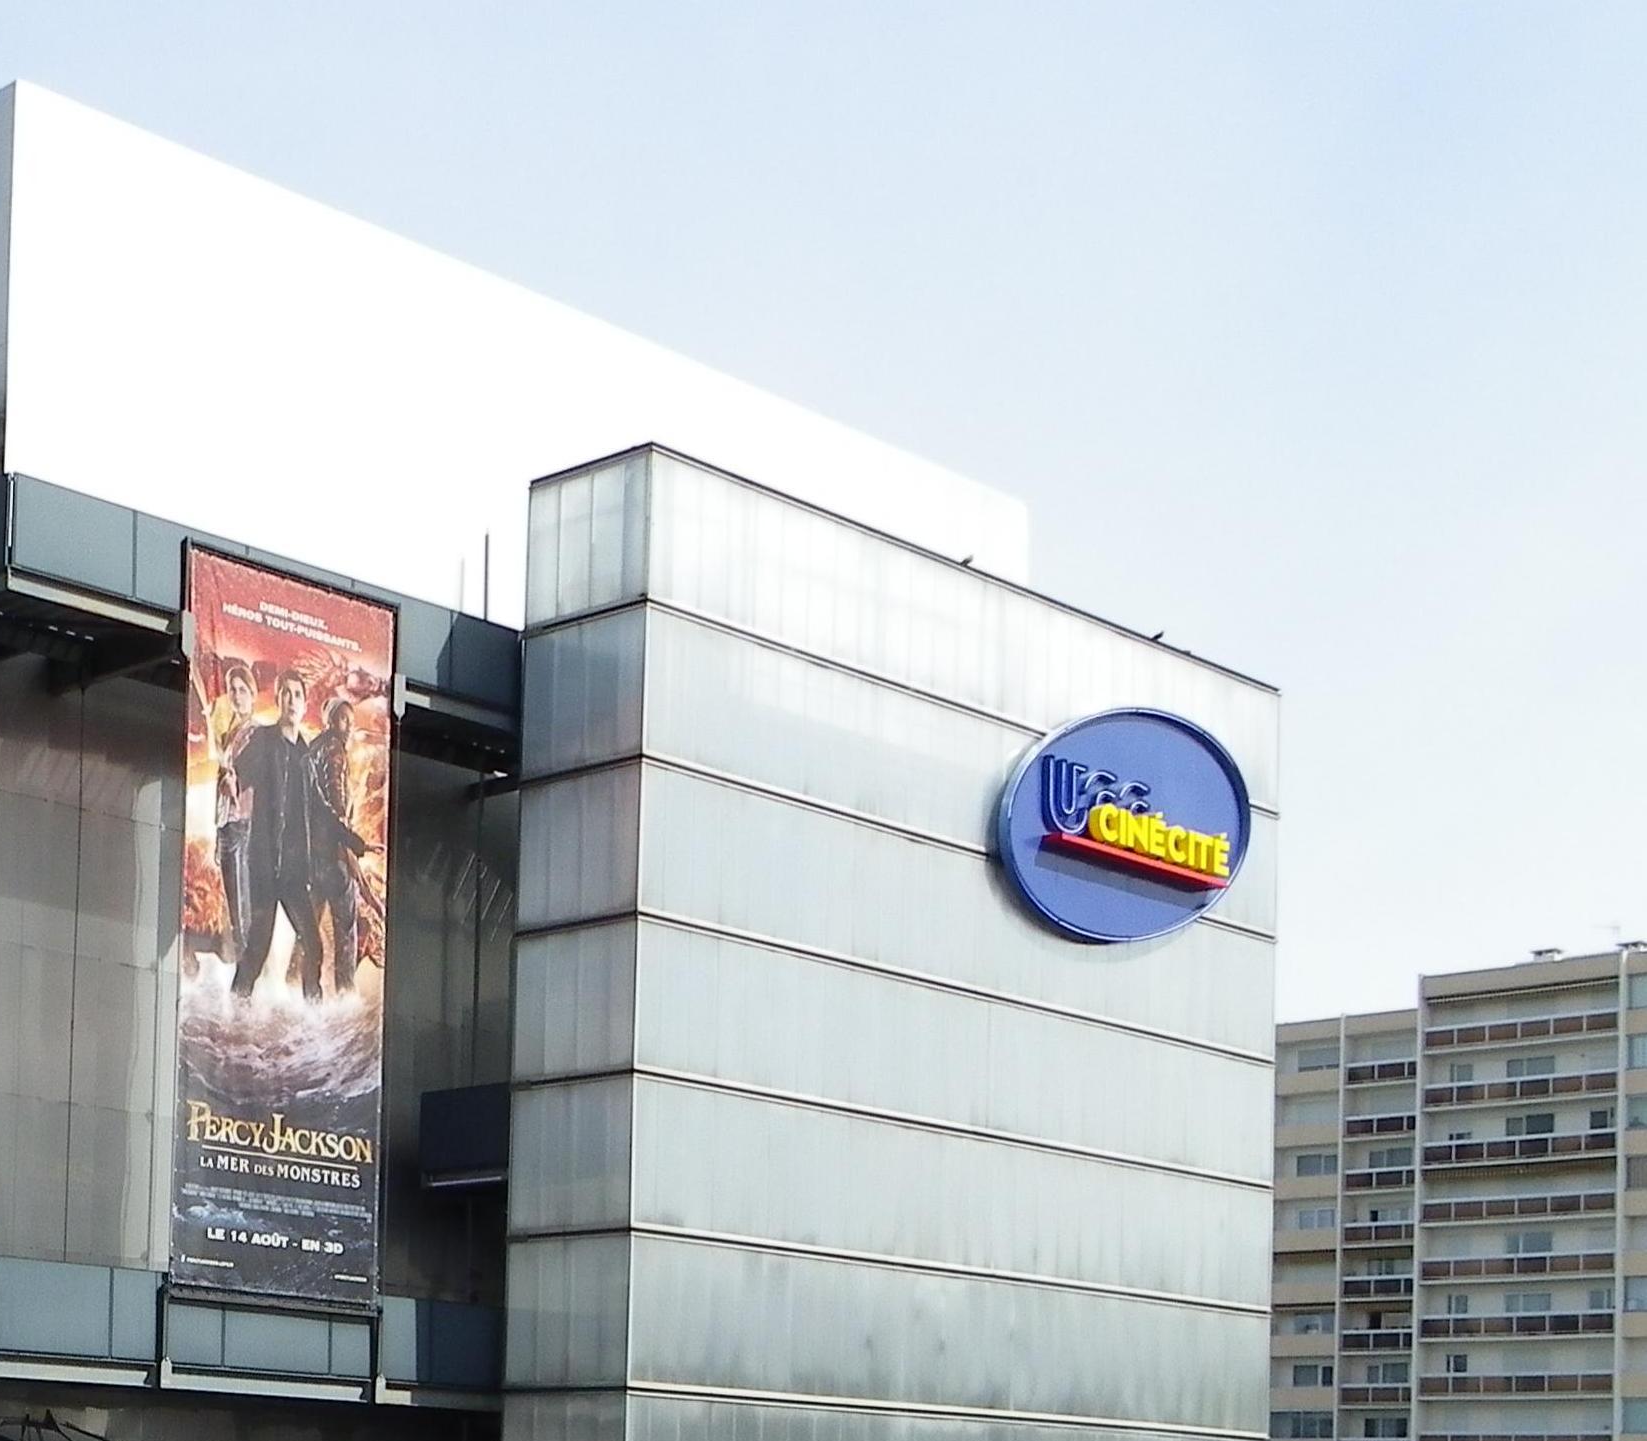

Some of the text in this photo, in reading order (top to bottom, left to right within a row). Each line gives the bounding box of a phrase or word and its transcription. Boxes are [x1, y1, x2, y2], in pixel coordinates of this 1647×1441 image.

[222, 602, 263, 623] HÉROS
[186, 1100, 373, 1163] PERCY JACKSON
[200, 1155, 361, 1188] LA MER DES MONSTRES
[207, 1227, 225, 1241] LE
[230, 1230, 247, 1244] 14
[251, 1232, 289, 1248] AOÛT
[302, 1239, 322, 1251] EN
[323, 1241, 344, 1255] 3D
